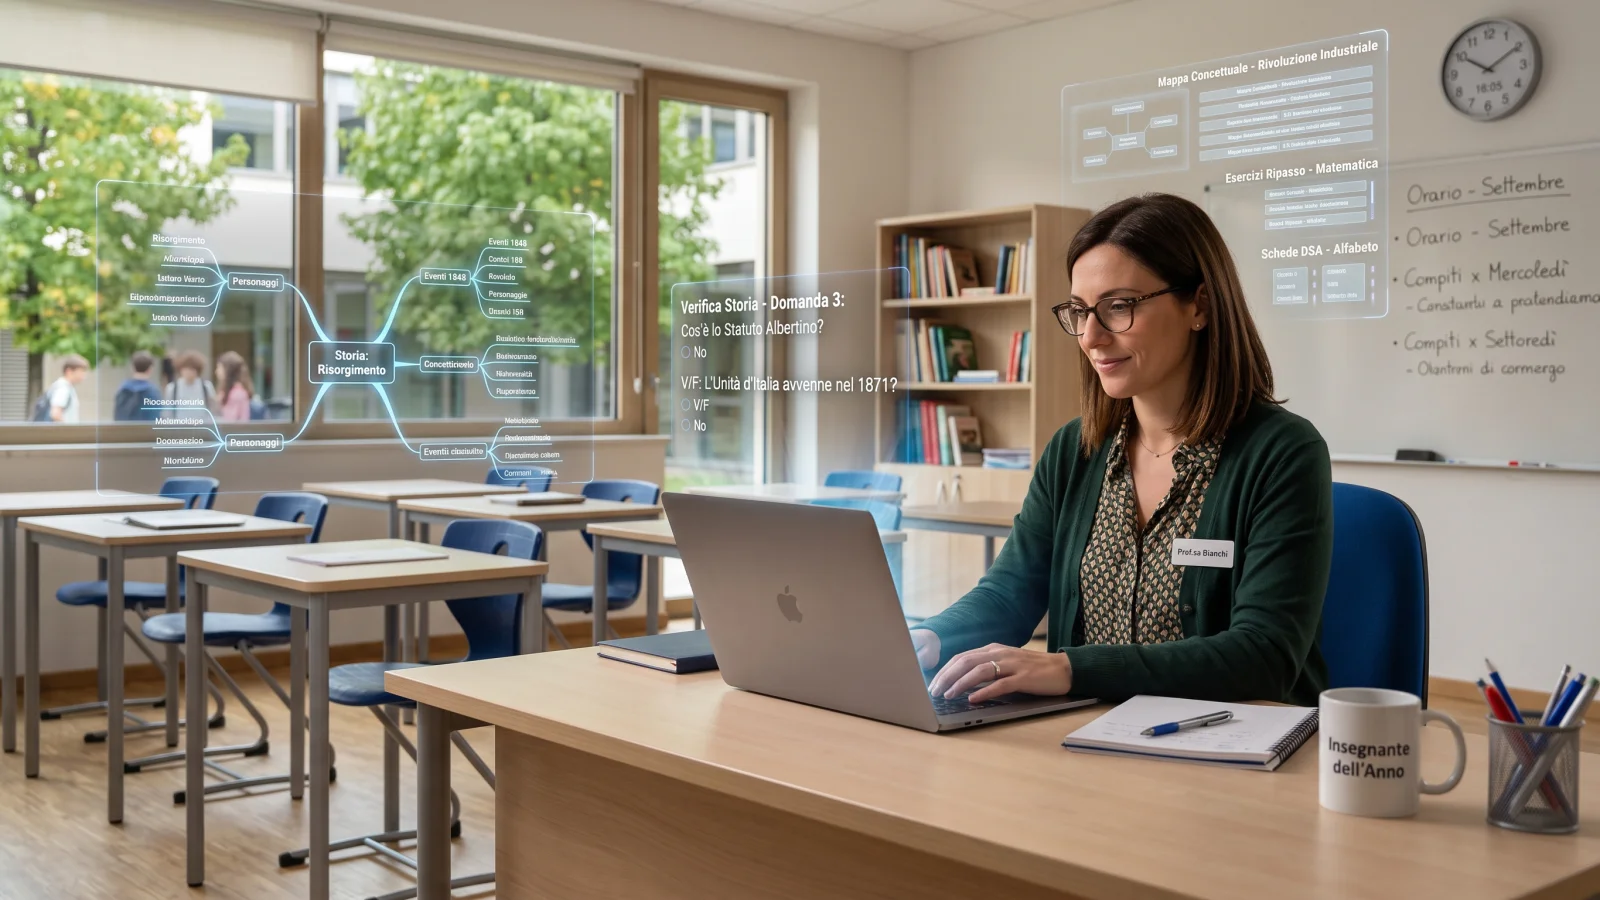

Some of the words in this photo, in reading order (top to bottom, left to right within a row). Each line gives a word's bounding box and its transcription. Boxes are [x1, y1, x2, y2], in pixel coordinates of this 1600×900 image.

[1483, 28, 1495, 40] 12
[1504, 30, 1509, 41] 1
[1468, 36, 1477, 48] 11
[1158, 75, 1189, 88] Mappa
[1191, 63, 1248, 82] Concettuale
[1258, 52, 1317, 71] Rivoluzione
[1320, 40, 1378, 61] Industriale
[1520, 58, 1527, 70] 3
[1450, 69, 1458, 81] 9
[1514, 78, 1521, 89] 4
[1456, 86, 1463, 98] 8
[1502, 92, 1509, 105] 5
[1468, 97, 1475, 108] 7
[1484, 100, 1492, 112] 6
[1226, 170, 1263, 184] Esercizi
[1266, 166, 1306, 181] Ripasso
[1316, 158, 1379, 174] Matematica
[1407, 184, 1462, 205] Orario
[1482, 174, 1565, 196] Settembre
[1406, 226, 1462, 247] Orario
[1488, 216, 1571, 239] Settembre
[152, 234, 206, 245] Risorgimento
[488, 238, 509, 246] Eventi
[511, 239, 528, 247] 1848
[1262, 246, 1299, 259] Schede
[1302, 245, 1323, 257] DSA
[1333, 242, 1379, 255] Alfabeto
[232, 277, 279, 288] Personaggi
[424, 272, 446, 280] Eventi
[448, 273, 467, 281] 1848
[1404, 266, 1462, 293] Compiti
[1472, 272, 1480, 283] x
[1489, 259, 1569, 282] Mercoledì
[681, 299, 722, 315] Verifica
[725, 297, 758, 313] Storia
[770, 293, 829, 310] Domanda
[832, 292, 845, 308] 3:
[681, 323, 709, 338] Cos'è
[712, 322, 722, 337] lo
[724, 321, 763, 336] Statuto
[766, 318, 824, 336] Albertino?
[1404, 330, 1460, 356] Compiti
[1469, 338, 1478, 348] x
[1485, 330, 1558, 349] Settoredì
[335, 350, 369, 361] Storia:
[694, 346, 707, 359] No
[318, 364, 386, 378] Risorgimento
[1480, 360, 1494, 376] di
[681, 376, 702, 391] V/F:
[704, 376, 741, 391] L'Unità
[744, 376, 780, 392] d'Italia
[783, 378, 832, 392] avvenne
[836, 377, 854, 393] nel
[858, 377, 898, 393] 1871?
[694, 398, 710, 412] V/F
[694, 419, 707, 432] No
[1203, 550, 1228, 558] Bianchi
[1328, 736, 1410, 759] Insegnante
[1333, 759, 1405, 780] dell'Anno
